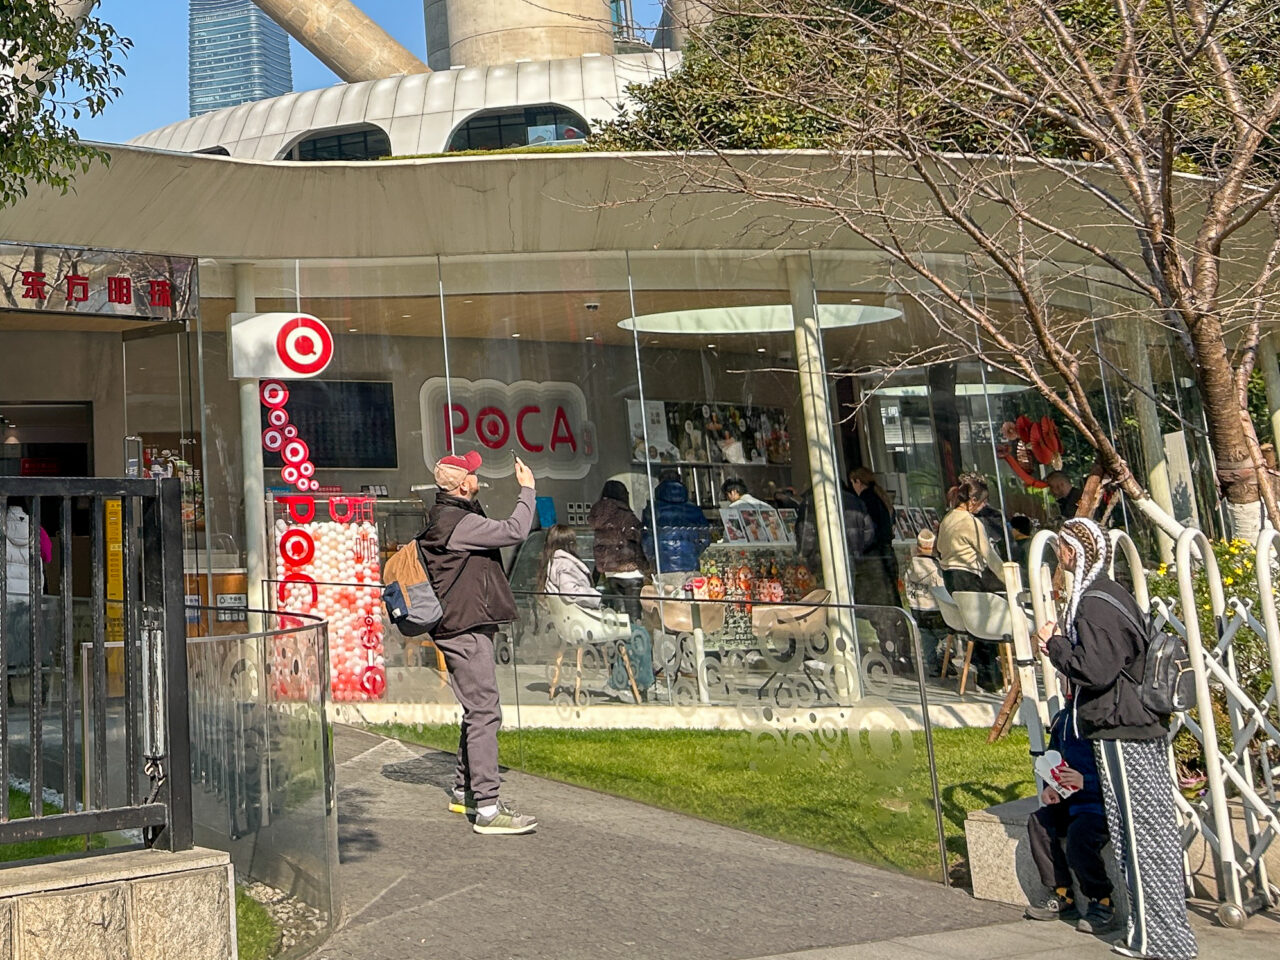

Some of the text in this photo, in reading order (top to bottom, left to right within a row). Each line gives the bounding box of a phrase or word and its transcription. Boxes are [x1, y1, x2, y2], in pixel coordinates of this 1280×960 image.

[21, 271, 172, 307] 东方明珠
[443, 403, 578, 453] POCA
